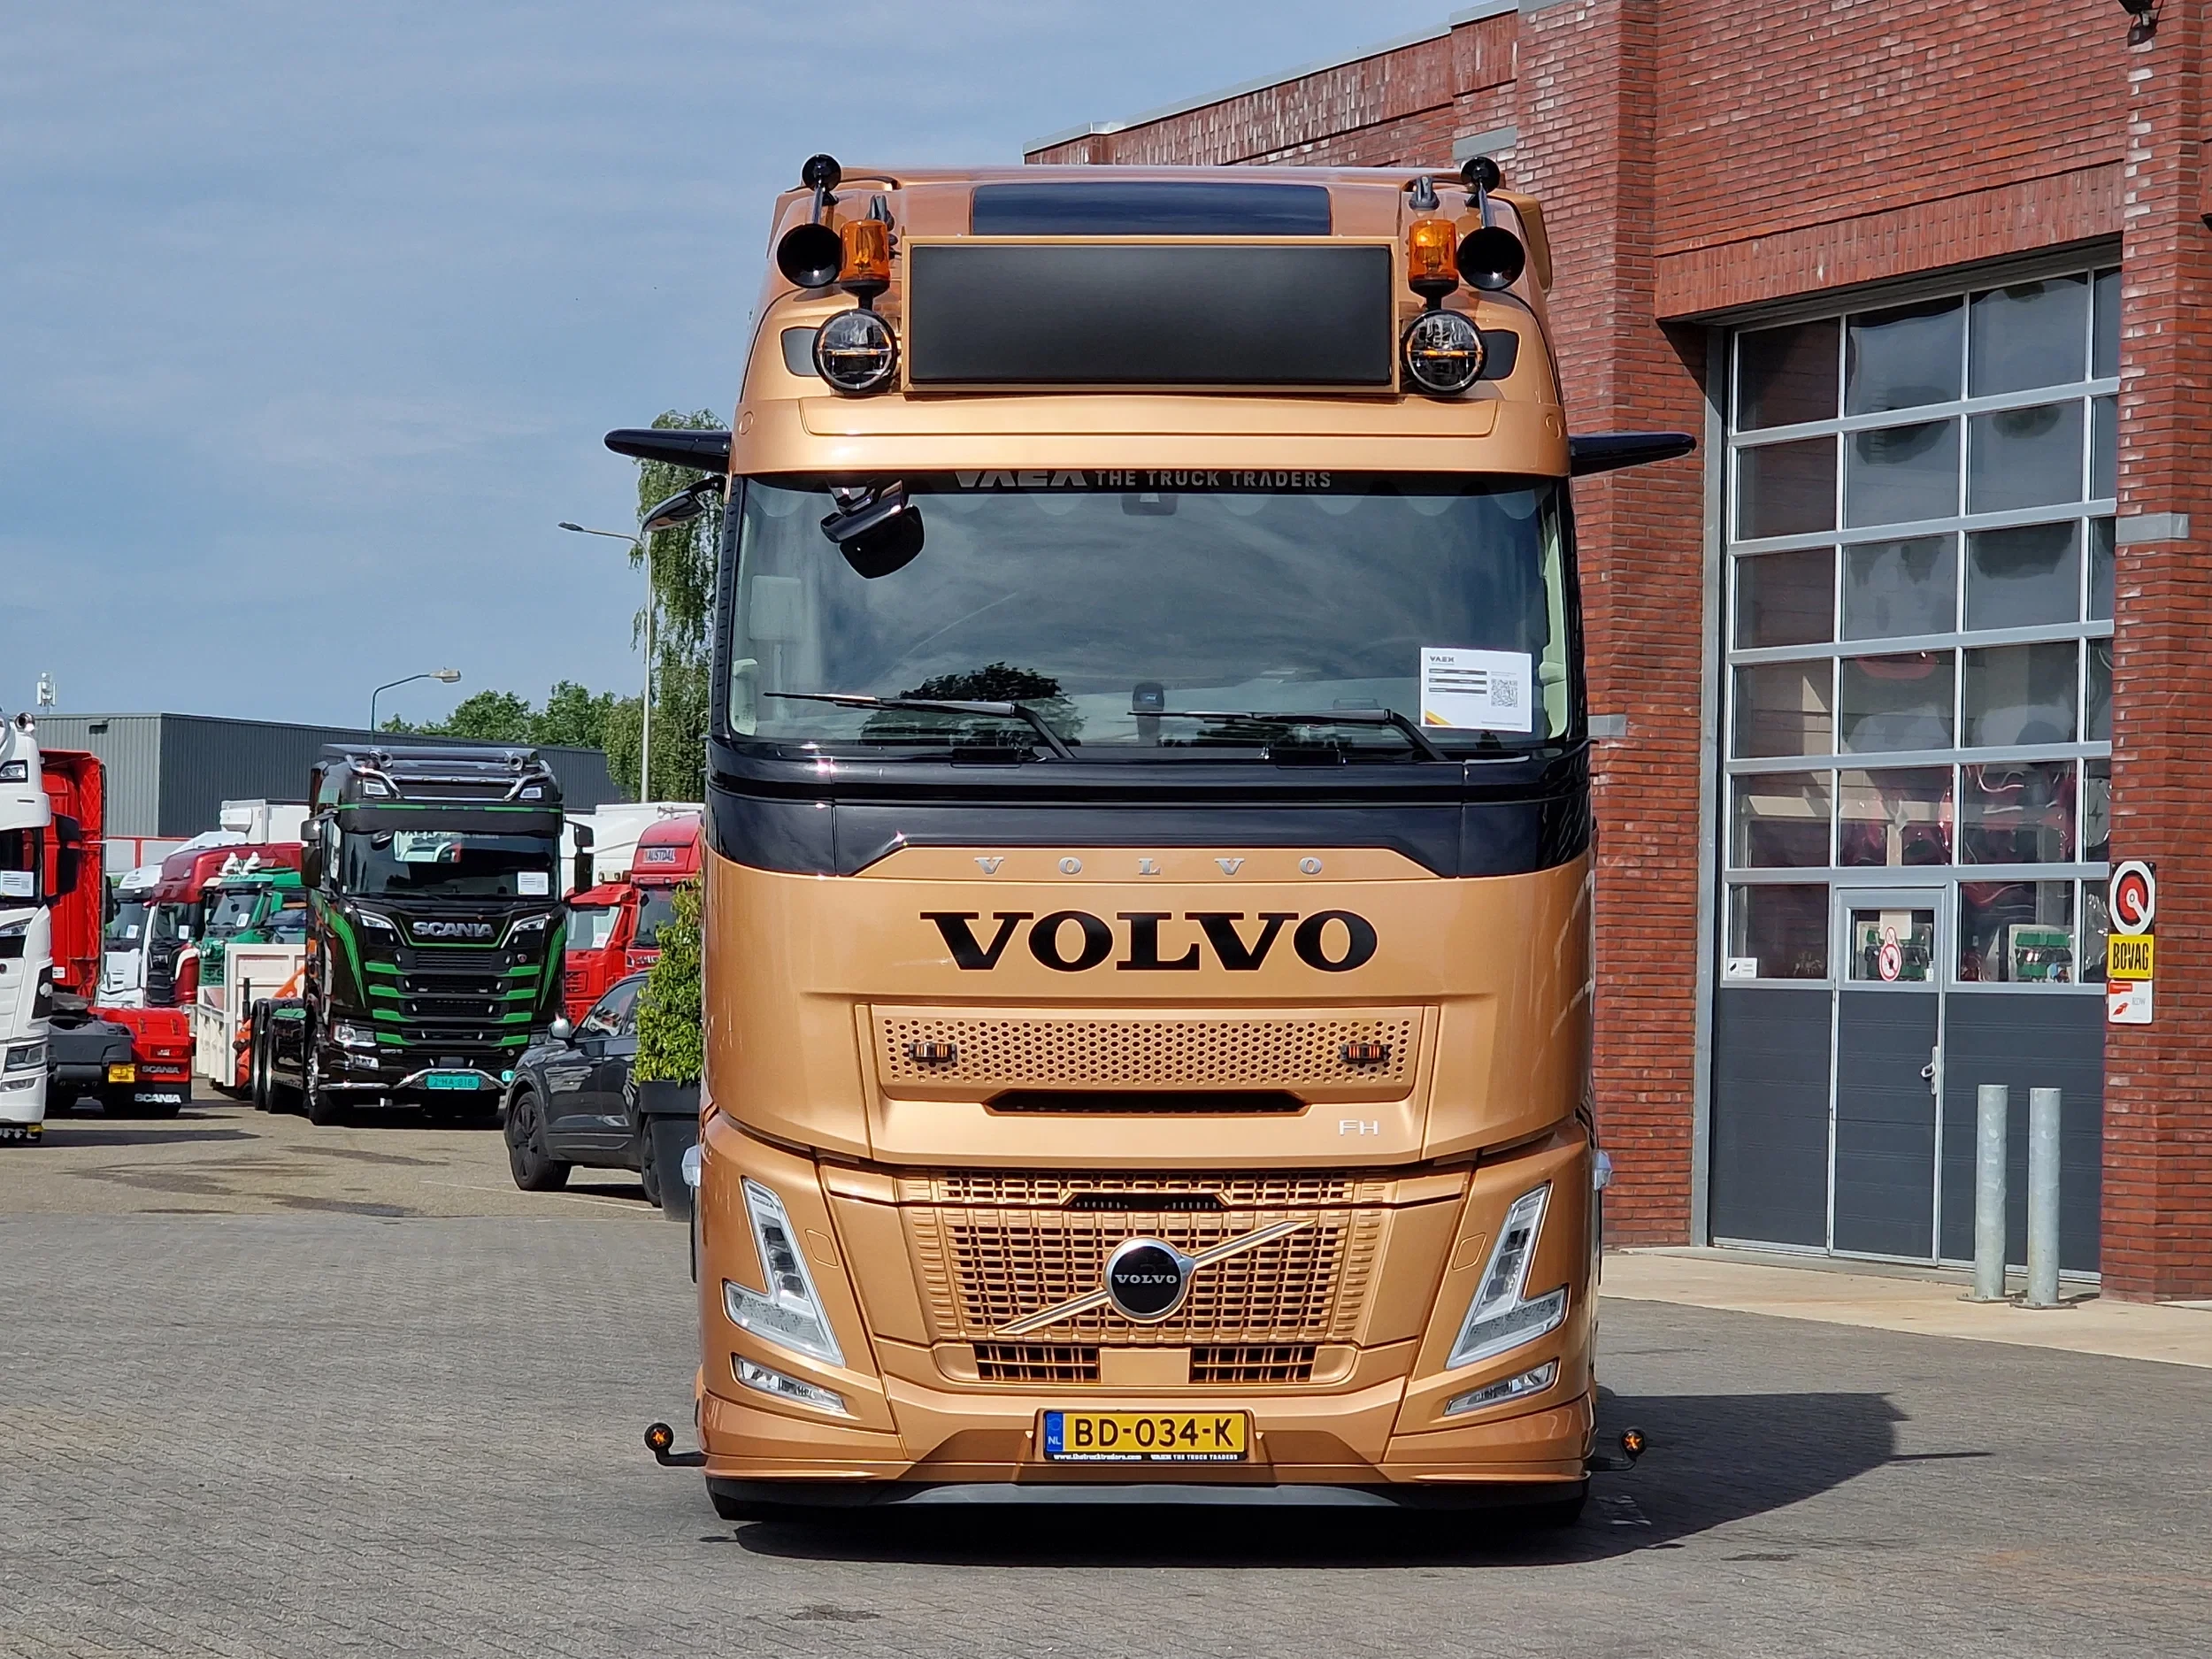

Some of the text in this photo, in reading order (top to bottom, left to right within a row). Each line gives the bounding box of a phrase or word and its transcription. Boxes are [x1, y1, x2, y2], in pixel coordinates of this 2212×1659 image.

[1095, 470, 1136, 487] THE
[1147, 470, 1220, 487] TRUCK
[1231, 471, 1332, 488] TRADERS
[412, 922, 495, 938] SCANIA
[919, 909, 1378, 972] VOLVO
[2113, 942, 2149, 971] BOVAG
[142, 1065, 180, 1074] SCANIA
[134, 1094, 181, 1103] SCANIA
[1339, 1120, 1379, 1135] FH
[1115, 1274, 1178, 1284] VOLVO
[1075, 1418, 1233, 1448] BD-034-K
[1048, 1437, 1062, 1446] NL
